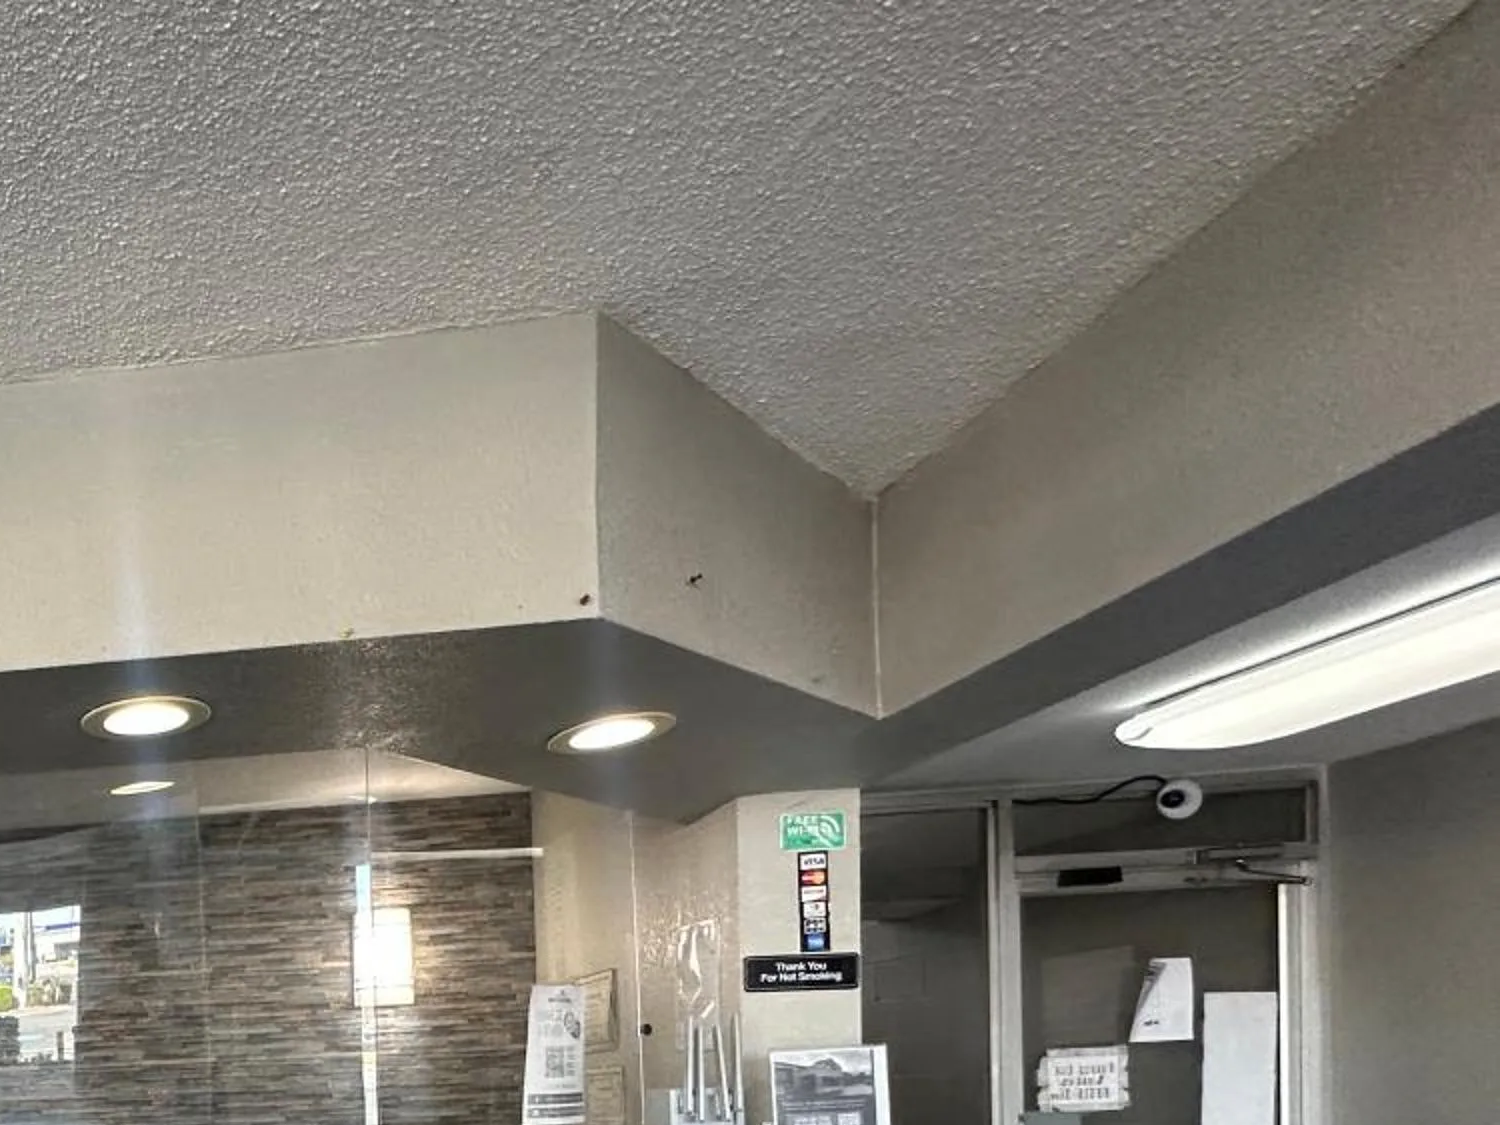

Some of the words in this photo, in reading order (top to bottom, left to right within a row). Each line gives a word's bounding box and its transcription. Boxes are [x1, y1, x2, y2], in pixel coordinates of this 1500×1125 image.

[775, 961, 806, 972] Thank
[807, 961, 827, 971] You
[760, 973, 778, 983] For
[779, 972, 797, 982] Not
[797, 971, 843, 982] Smoking
